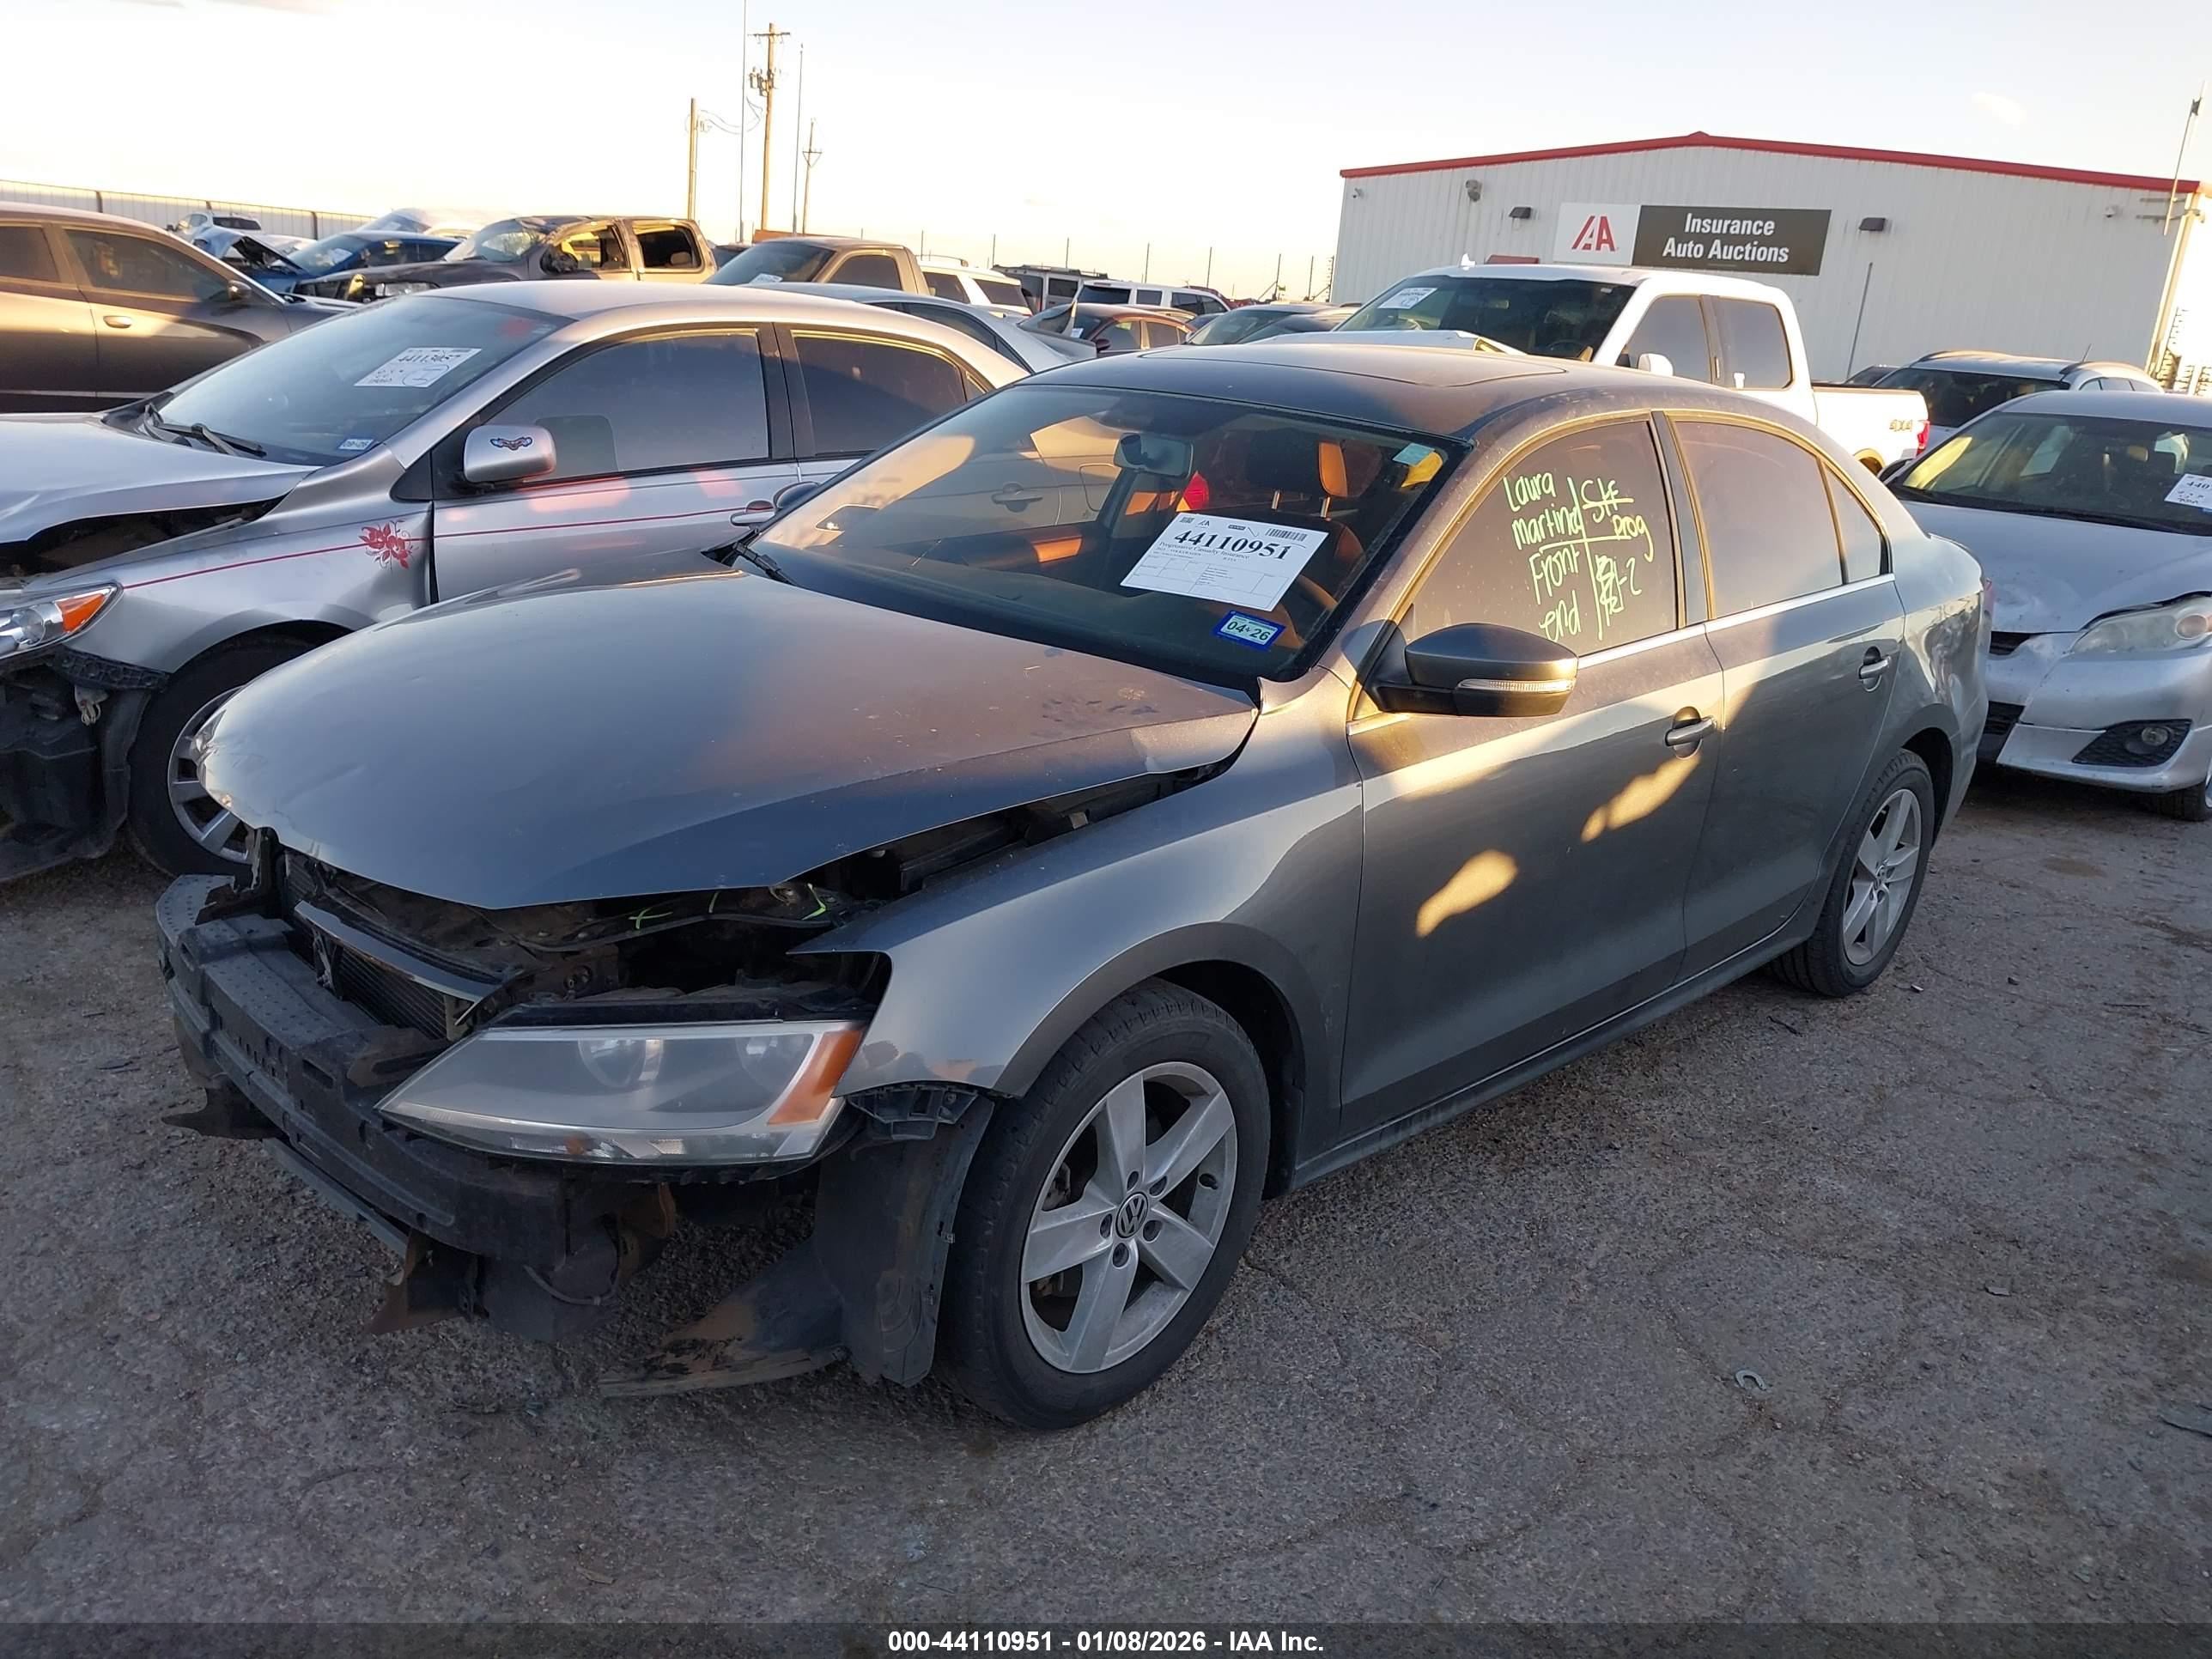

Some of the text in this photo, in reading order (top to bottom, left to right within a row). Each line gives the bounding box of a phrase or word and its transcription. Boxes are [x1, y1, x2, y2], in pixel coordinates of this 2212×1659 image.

[1685, 213, 1776, 236] Insurance
[1662, 238, 1790, 263] Auto Auctions
[1504, 473, 1556, 512] Laura
[1174, 530, 1292, 561] 44110951
[1529, 544, 1580, 605] Front
[1227, 621, 1271, 641] 04 26
[1538, 589, 1582, 643] end
